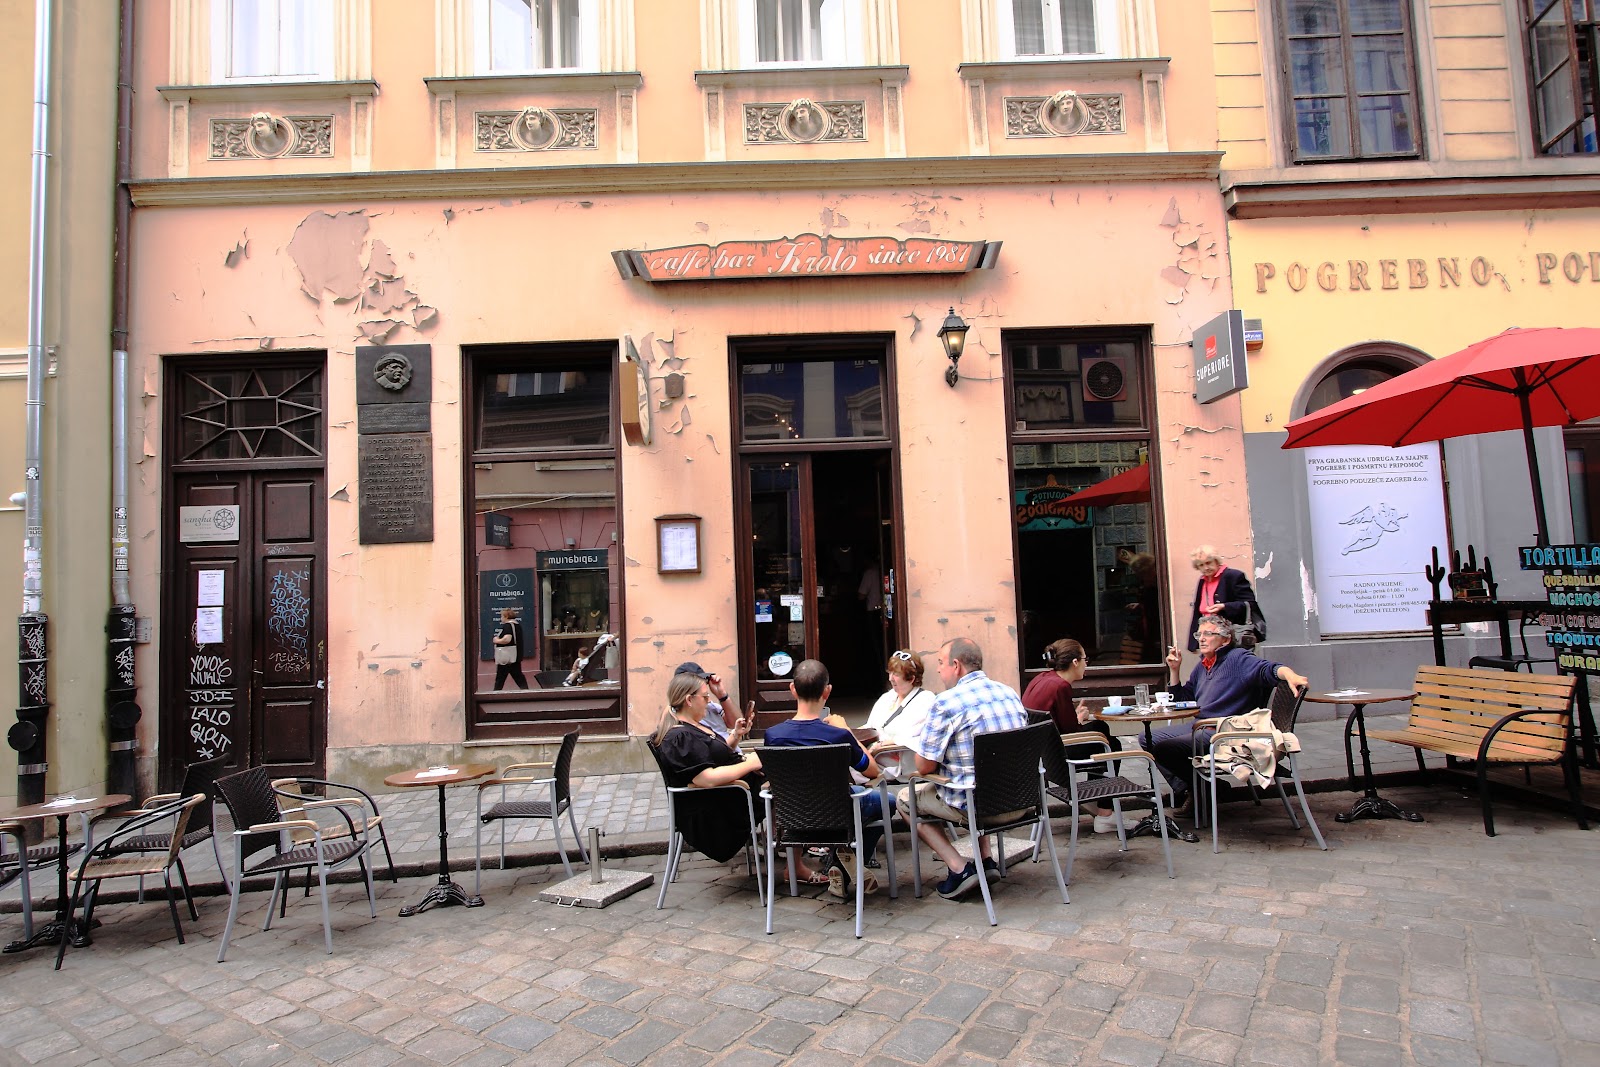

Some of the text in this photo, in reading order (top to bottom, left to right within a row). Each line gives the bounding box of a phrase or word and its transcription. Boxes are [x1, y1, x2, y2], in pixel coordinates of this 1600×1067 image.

[713, 249, 756, 269] bar
[767, 242, 857, 274] Krolo
[868, 244, 921, 265] since
[926, 245, 968, 264] 1981
[1254, 255, 1492, 293] POGREBNO
[1196, 354, 1230, 382] SUPERIORE
[1315, 464, 1347, 472] POGREBE
[1389, 461, 1424, 469] PRIPOMOĆ
[1313, 478, 1349, 486] POGREBNO
[1350, 476, 1384, 484] PODUZEĆE
[184, 509, 212, 527] sangha
[1549, 592, 1600, 607] NACHOS
